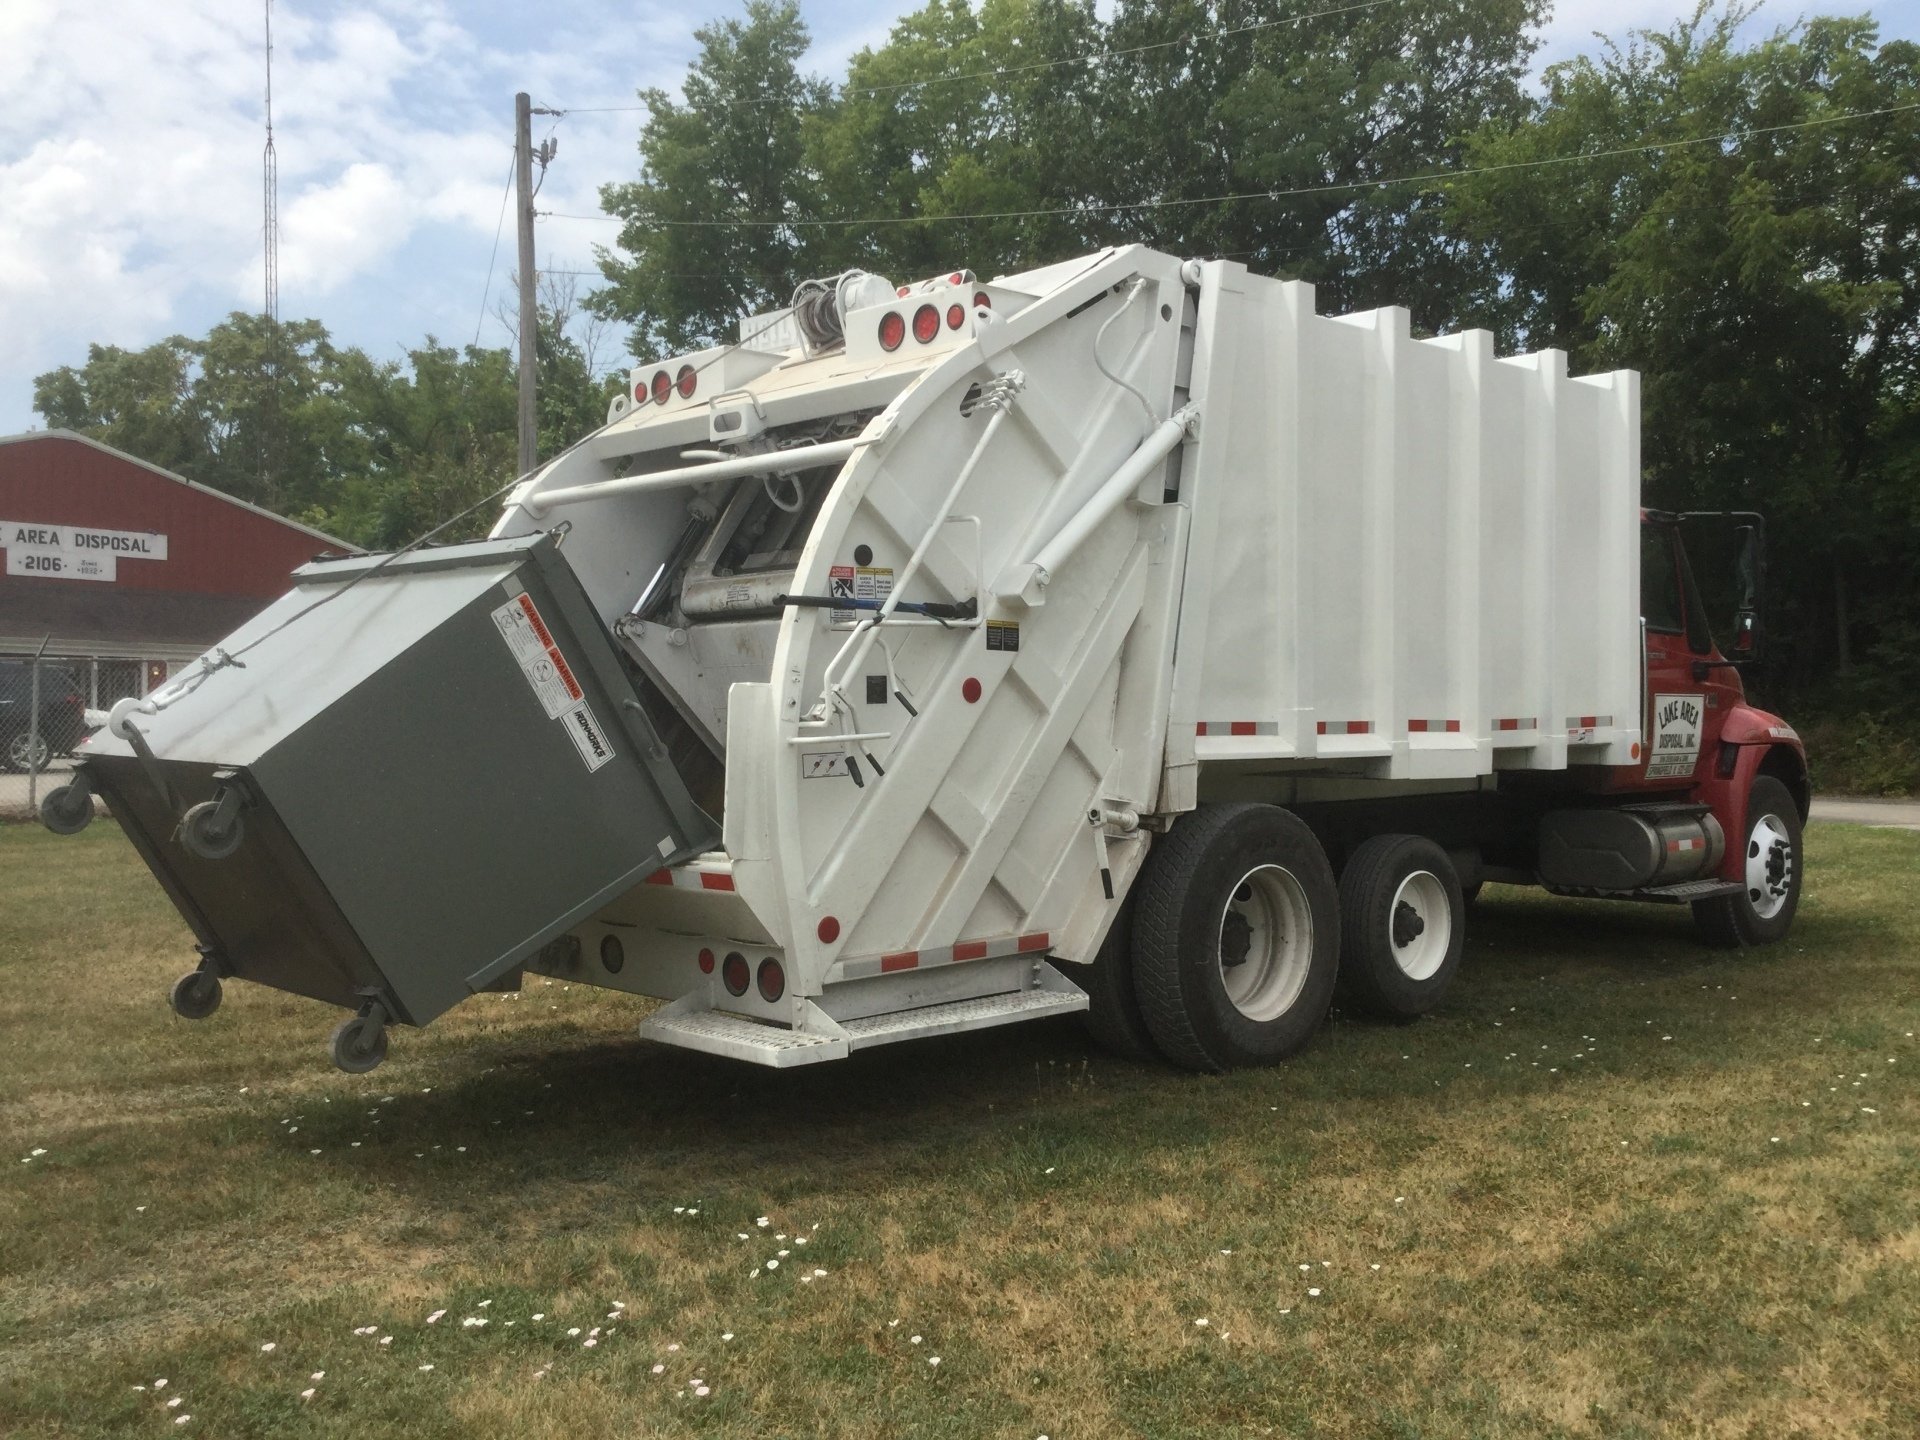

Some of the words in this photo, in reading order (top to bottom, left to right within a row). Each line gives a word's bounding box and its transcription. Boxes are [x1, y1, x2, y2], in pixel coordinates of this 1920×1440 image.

[16, 529, 60, 546] AREA
[75, 533, 151, 553] DISPOSAL
[25, 555, 62, 572] 2106
[524, 603, 552, 647] WARNING
[552, 653, 581, 699] WARNING
[1659, 701, 1679, 730] LAKE
[1680, 701, 1699, 729] AREA
[574, 710, 606, 759] IRONWORKS
